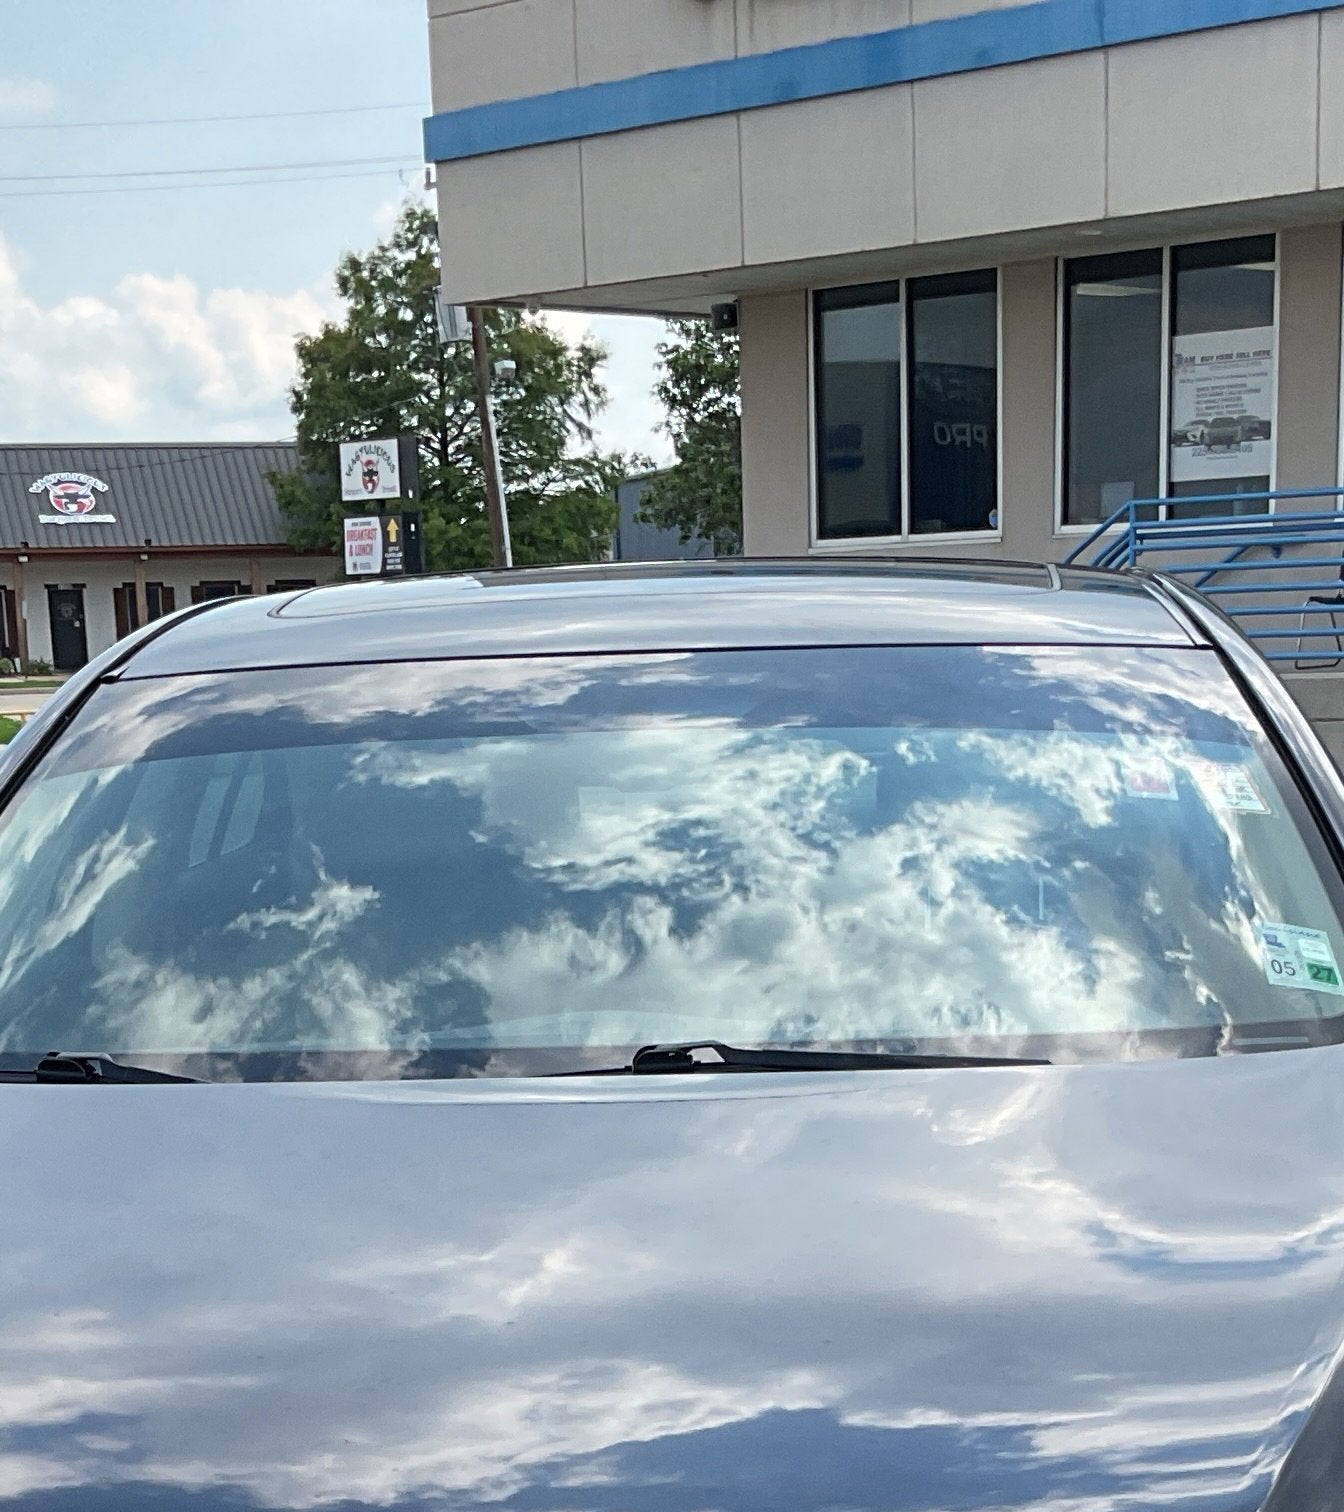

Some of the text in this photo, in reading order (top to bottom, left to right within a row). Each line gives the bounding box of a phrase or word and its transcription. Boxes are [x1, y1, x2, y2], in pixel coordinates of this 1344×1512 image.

[356, 544, 373, 556] LUNCH
[1270, 959, 1334, 982] 05 27
